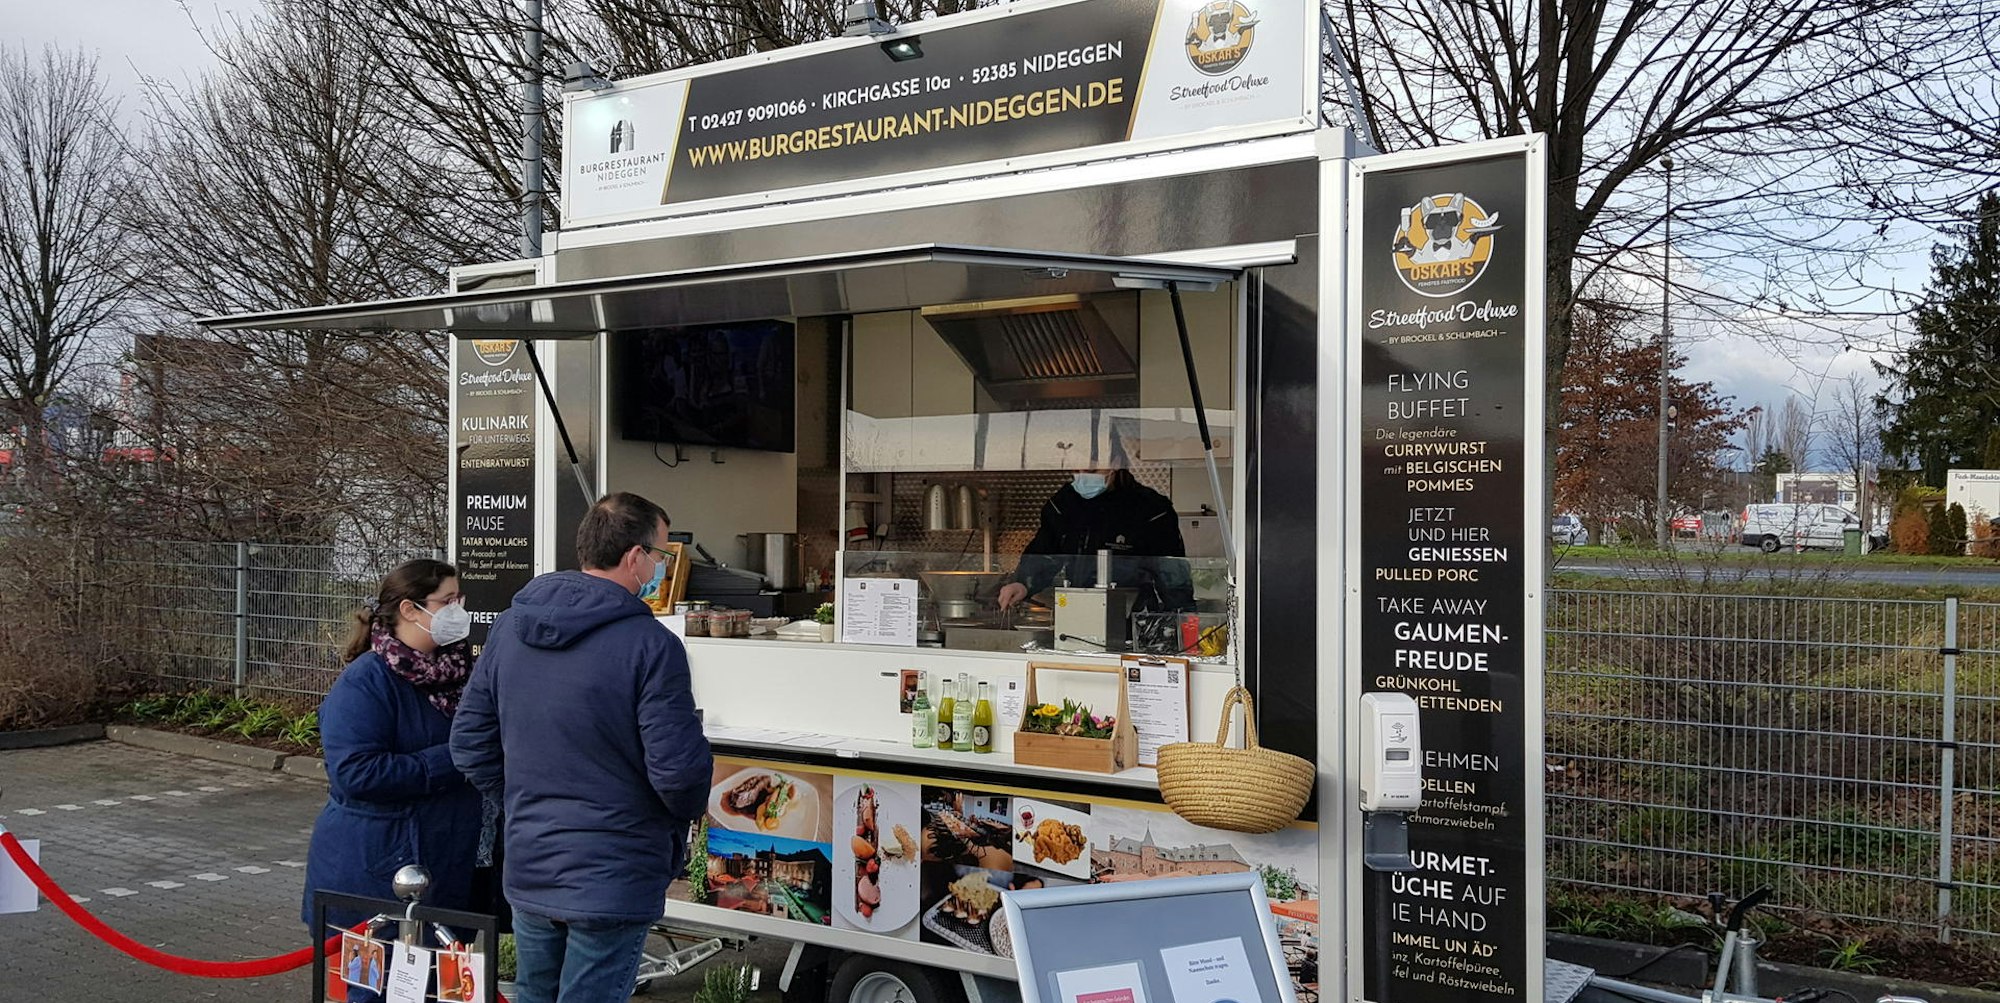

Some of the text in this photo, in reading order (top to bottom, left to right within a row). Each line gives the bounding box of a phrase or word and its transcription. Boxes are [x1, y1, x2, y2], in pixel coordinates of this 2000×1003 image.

[688, 41, 1123, 132] T 02427 9091066 KIRCHGASSE 10a 52385 NIDEGGEN
[1169, 74, 1269, 100] Streetfood Deluxe
[688, 78, 1124, 169] WWW.BURGRESTAURANT-NIDEGGEN.DE
[580, 152, 665, 175] BURGRESTAURANT
[597, 167, 647, 182] NIDEGGEN
[1368, 299, 1518, 329] Streetfood Deluxe
[1389, 329, 1498, 344] BY BROCKEL & SCHLIMBACH
[459, 368, 532, 387] Streetfood Deluxe
[1388, 370, 1469, 392] FLYING
[1388, 398, 1469, 420] BUFFET
[462, 415, 529, 431] KULINARIK
[469, 433, 530, 444] FÜR UNTERWEGS
[1376, 426, 1457, 441] Die legendäre
[1384, 442, 1487, 457] CURRYWURST
[460, 457, 530, 469] ENTENBRATWURST
[1384, 460, 1502, 475] mit BELGISCHEN
[1407, 479, 1474, 492] POMMES
[466, 494, 527, 510] PREMIUM
[466, 516, 505, 531] PAUSE
[1407, 507, 1455, 524] JETZT
[462, 537, 528, 547] TATAR VOM LACHS
[1408, 528, 1490, 541] UND HIER
[470, 549, 496, 557] Avocado
[1408, 547, 1508, 562] GENIESSEN
[494, 560, 505, 569] und
[506, 560, 529, 569] kleinem
[1375, 568, 1479, 582] PULLED PORC
[1377, 596, 1487, 615] TAKE AWAY
[467, 611, 501, 624] TREET
[1394, 622, 1509, 644] GAUMEN-
[1395, 649, 1489, 672] FREUDE
[1376, 674, 1461, 692] GRÜNKOHL
[1420, 750, 1499, 772] EHMEN
[1420, 796, 1508, 817] artoffelstampf,
[1407, 811, 1495, 830] chmorzwiebeln
[1410, 850, 1496, 877] URMET-
[1392, 871, 1507, 906] ÜCHE AUF
[1392, 902, 1487, 932] IE HAND
[1392, 932, 1440, 950] IMMEL
[1445, 939, 1467, 954] UN
[1415, 952, 1502, 978] Kartoffelpüree,
[1412, 970, 1435, 983] und
[1438, 971, 1515, 996] Röstzwiebeln
